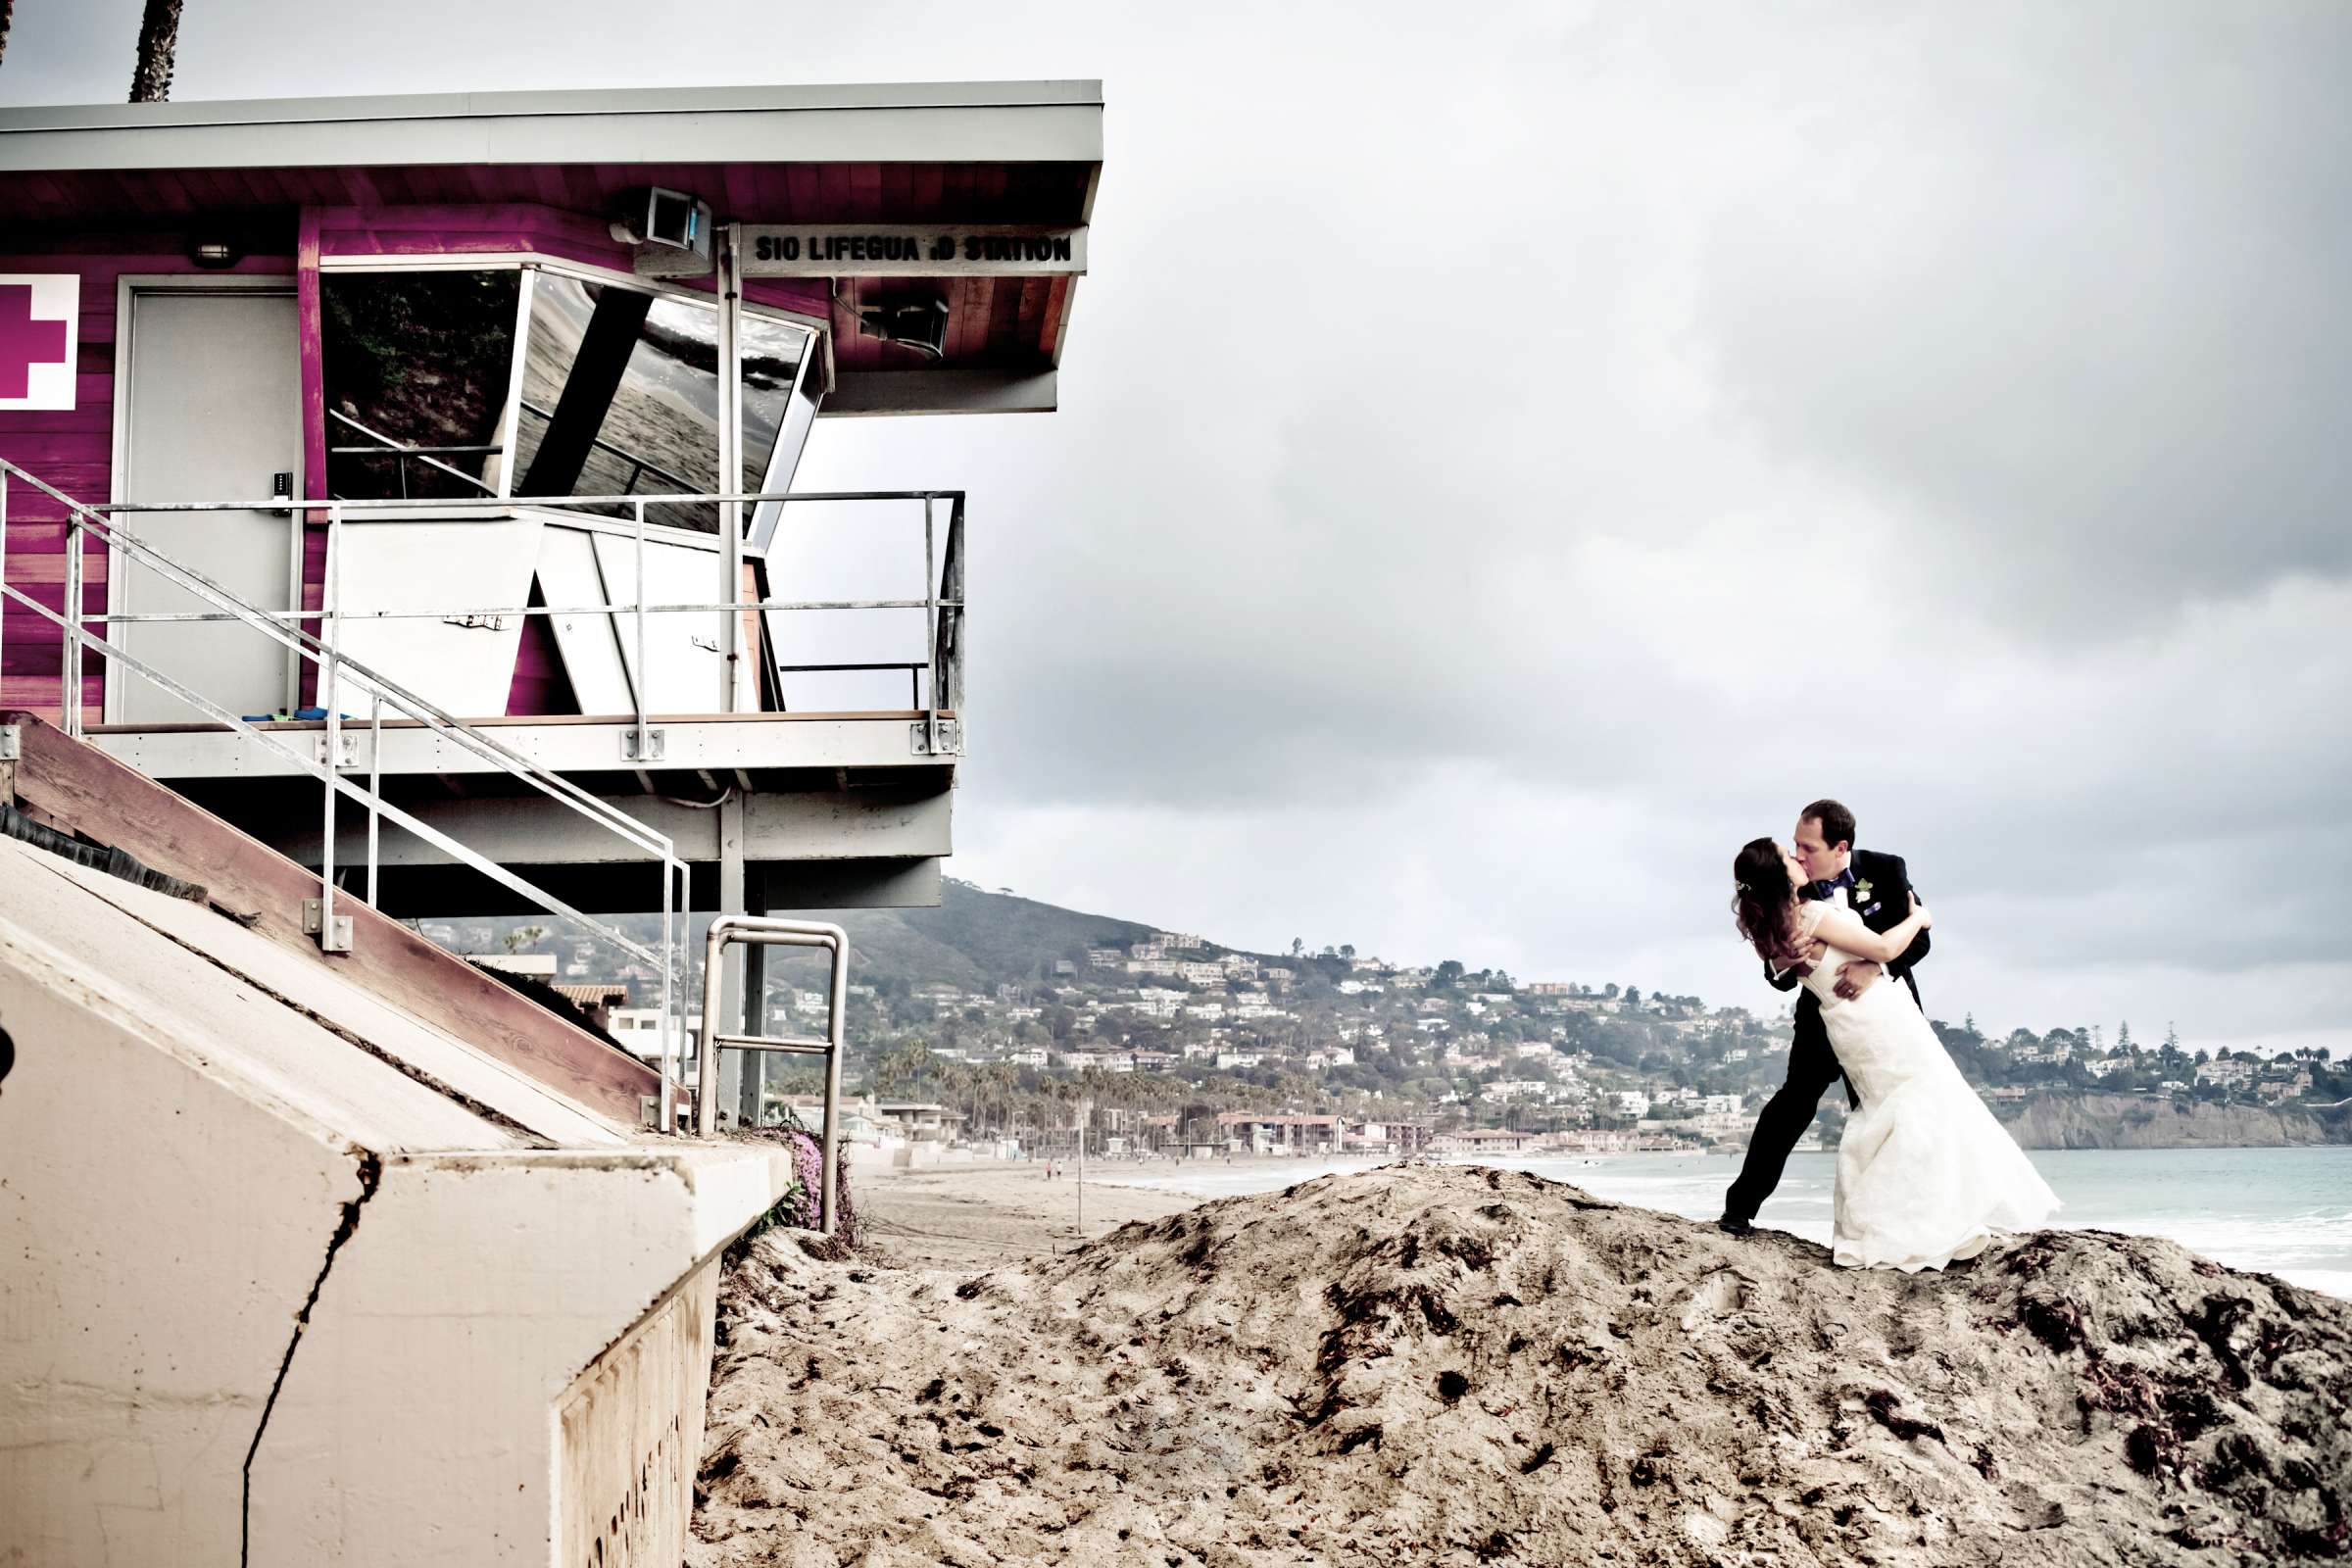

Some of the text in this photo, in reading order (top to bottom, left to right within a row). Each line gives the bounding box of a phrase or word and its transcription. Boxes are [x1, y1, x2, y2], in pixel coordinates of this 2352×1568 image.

[756, 235, 1070, 261] SIO LIFEGUAD STATION
